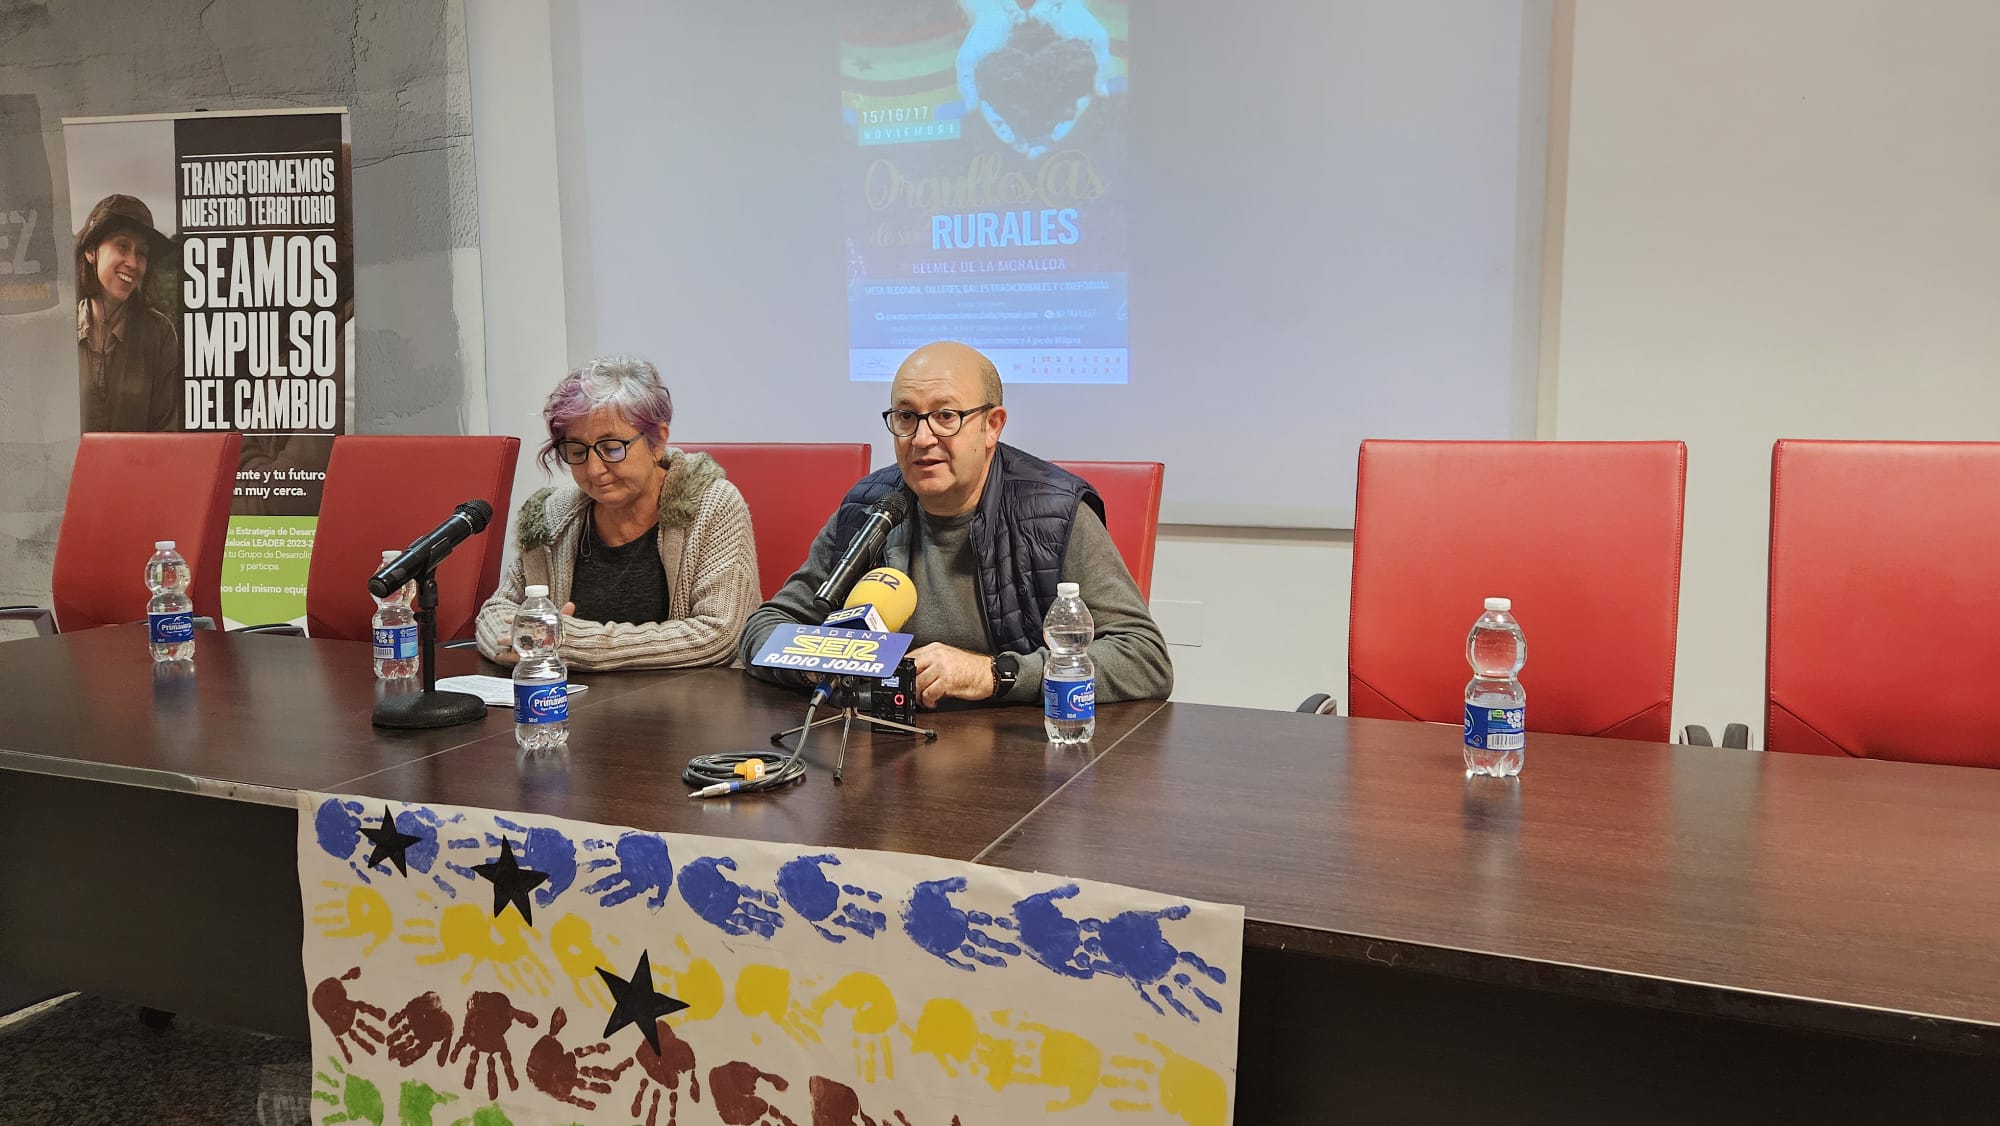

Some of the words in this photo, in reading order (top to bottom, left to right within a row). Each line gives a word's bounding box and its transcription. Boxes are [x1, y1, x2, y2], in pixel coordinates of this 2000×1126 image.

[181, 157, 335, 196] TRANSFORMEMOS
[182, 197, 247, 227] NUESTRO
[250, 194, 336, 226] TERRITORIO
[931, 208, 1081, 249] RURALES
[183, 235, 338, 309] SEAMOS
[184, 310, 337, 377] IMPULSO
[184, 380, 231, 430] DEL
[234, 378, 337, 430] CAMBIO
[263, 471, 271, 483] y
[273, 470, 287, 481] tu
[288, 467, 327, 481] futuro
[245, 487, 271, 499] muy
[272, 486, 307, 497] cerca.
[236, 527, 276, 538] Estrategia
[277, 527, 288, 536] de
[252, 539, 285, 548] LEADER
[238, 550, 262, 561] Grupo
[263, 550, 274, 559] de
[235, 583, 250, 594] del
[251, 584, 282, 594] mismo
[825, 606, 866, 624] SER
[796, 626, 889, 642] CADENA
[783, 634, 880, 662] SER
[764, 653, 821, 668] RADIO
[822, 658, 884, 674] JODAR
